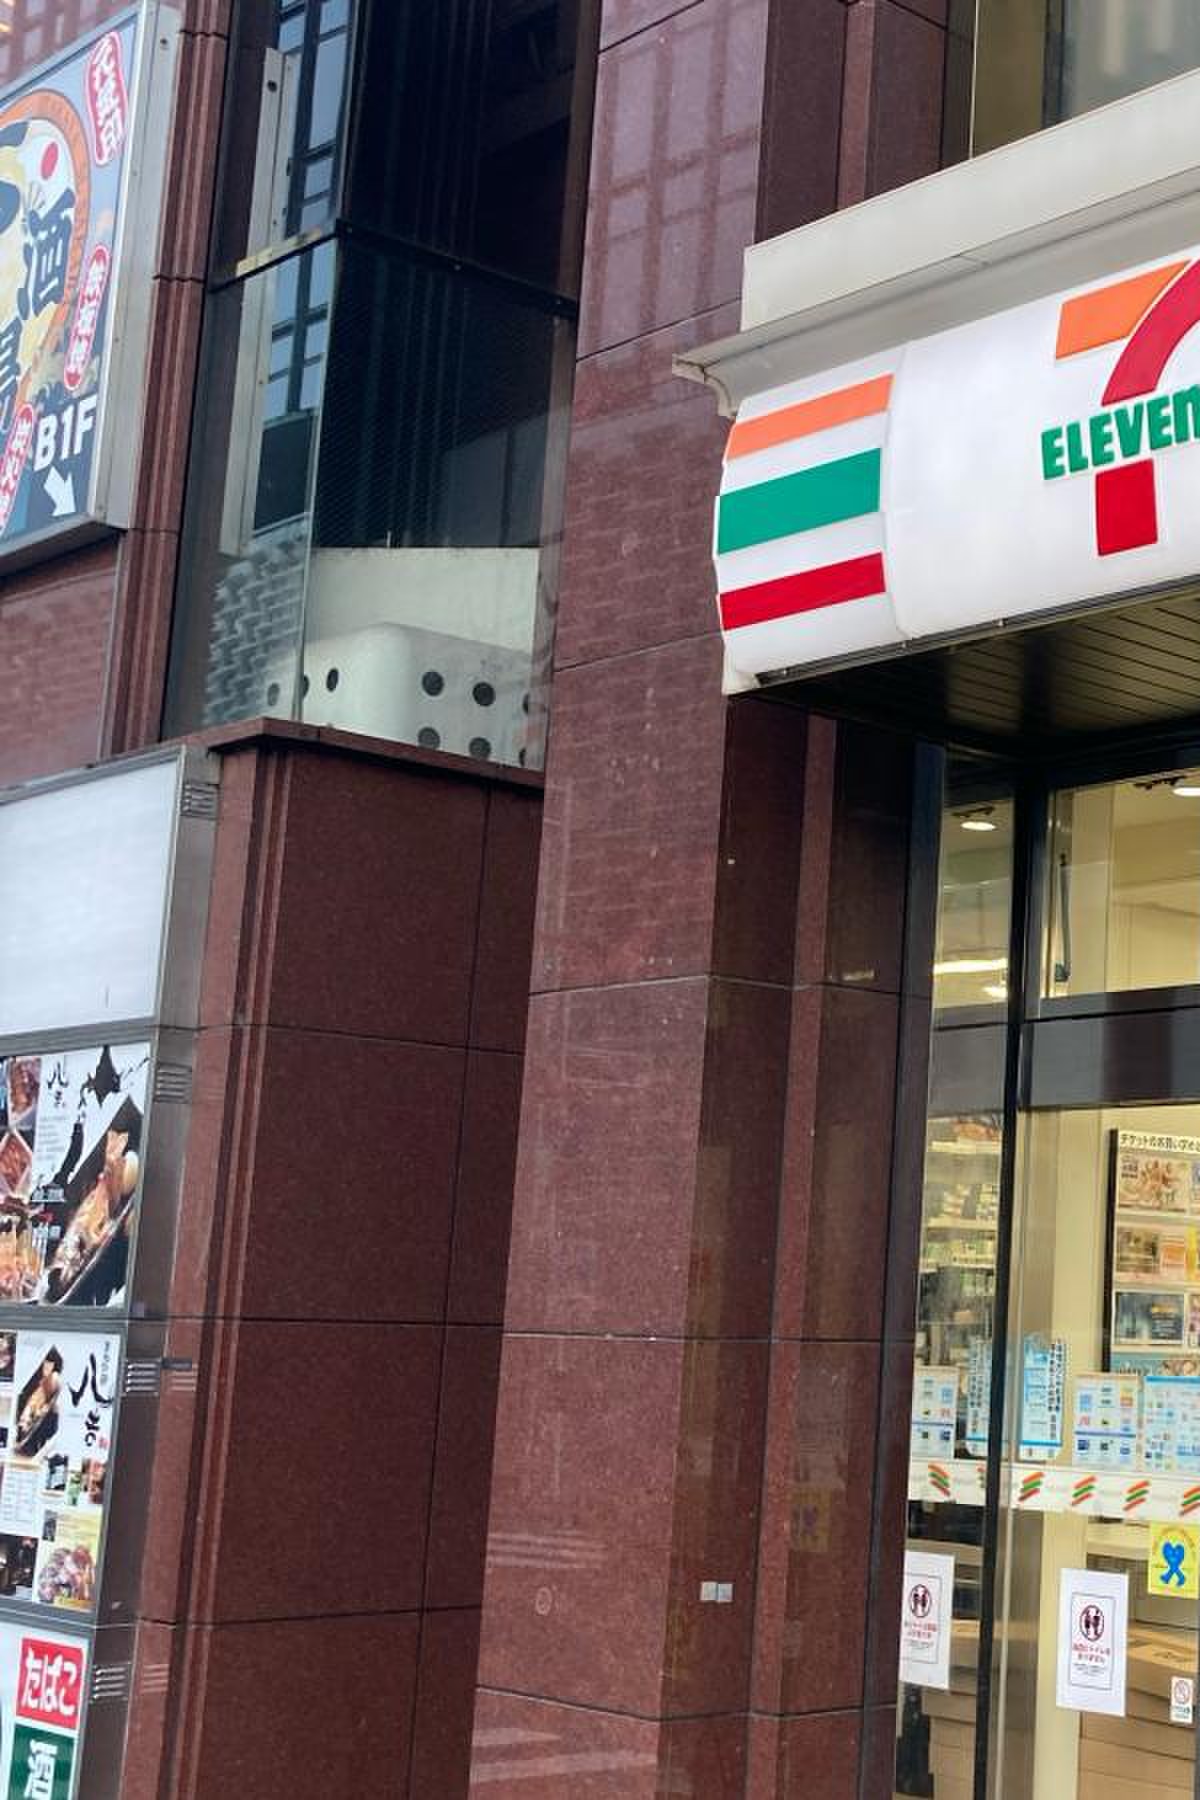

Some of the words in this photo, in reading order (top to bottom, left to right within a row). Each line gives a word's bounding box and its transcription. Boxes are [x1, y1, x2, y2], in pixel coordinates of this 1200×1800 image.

[33, 394, 98, 472] B1F
[22, 1646, 77, 1717] たばこ
